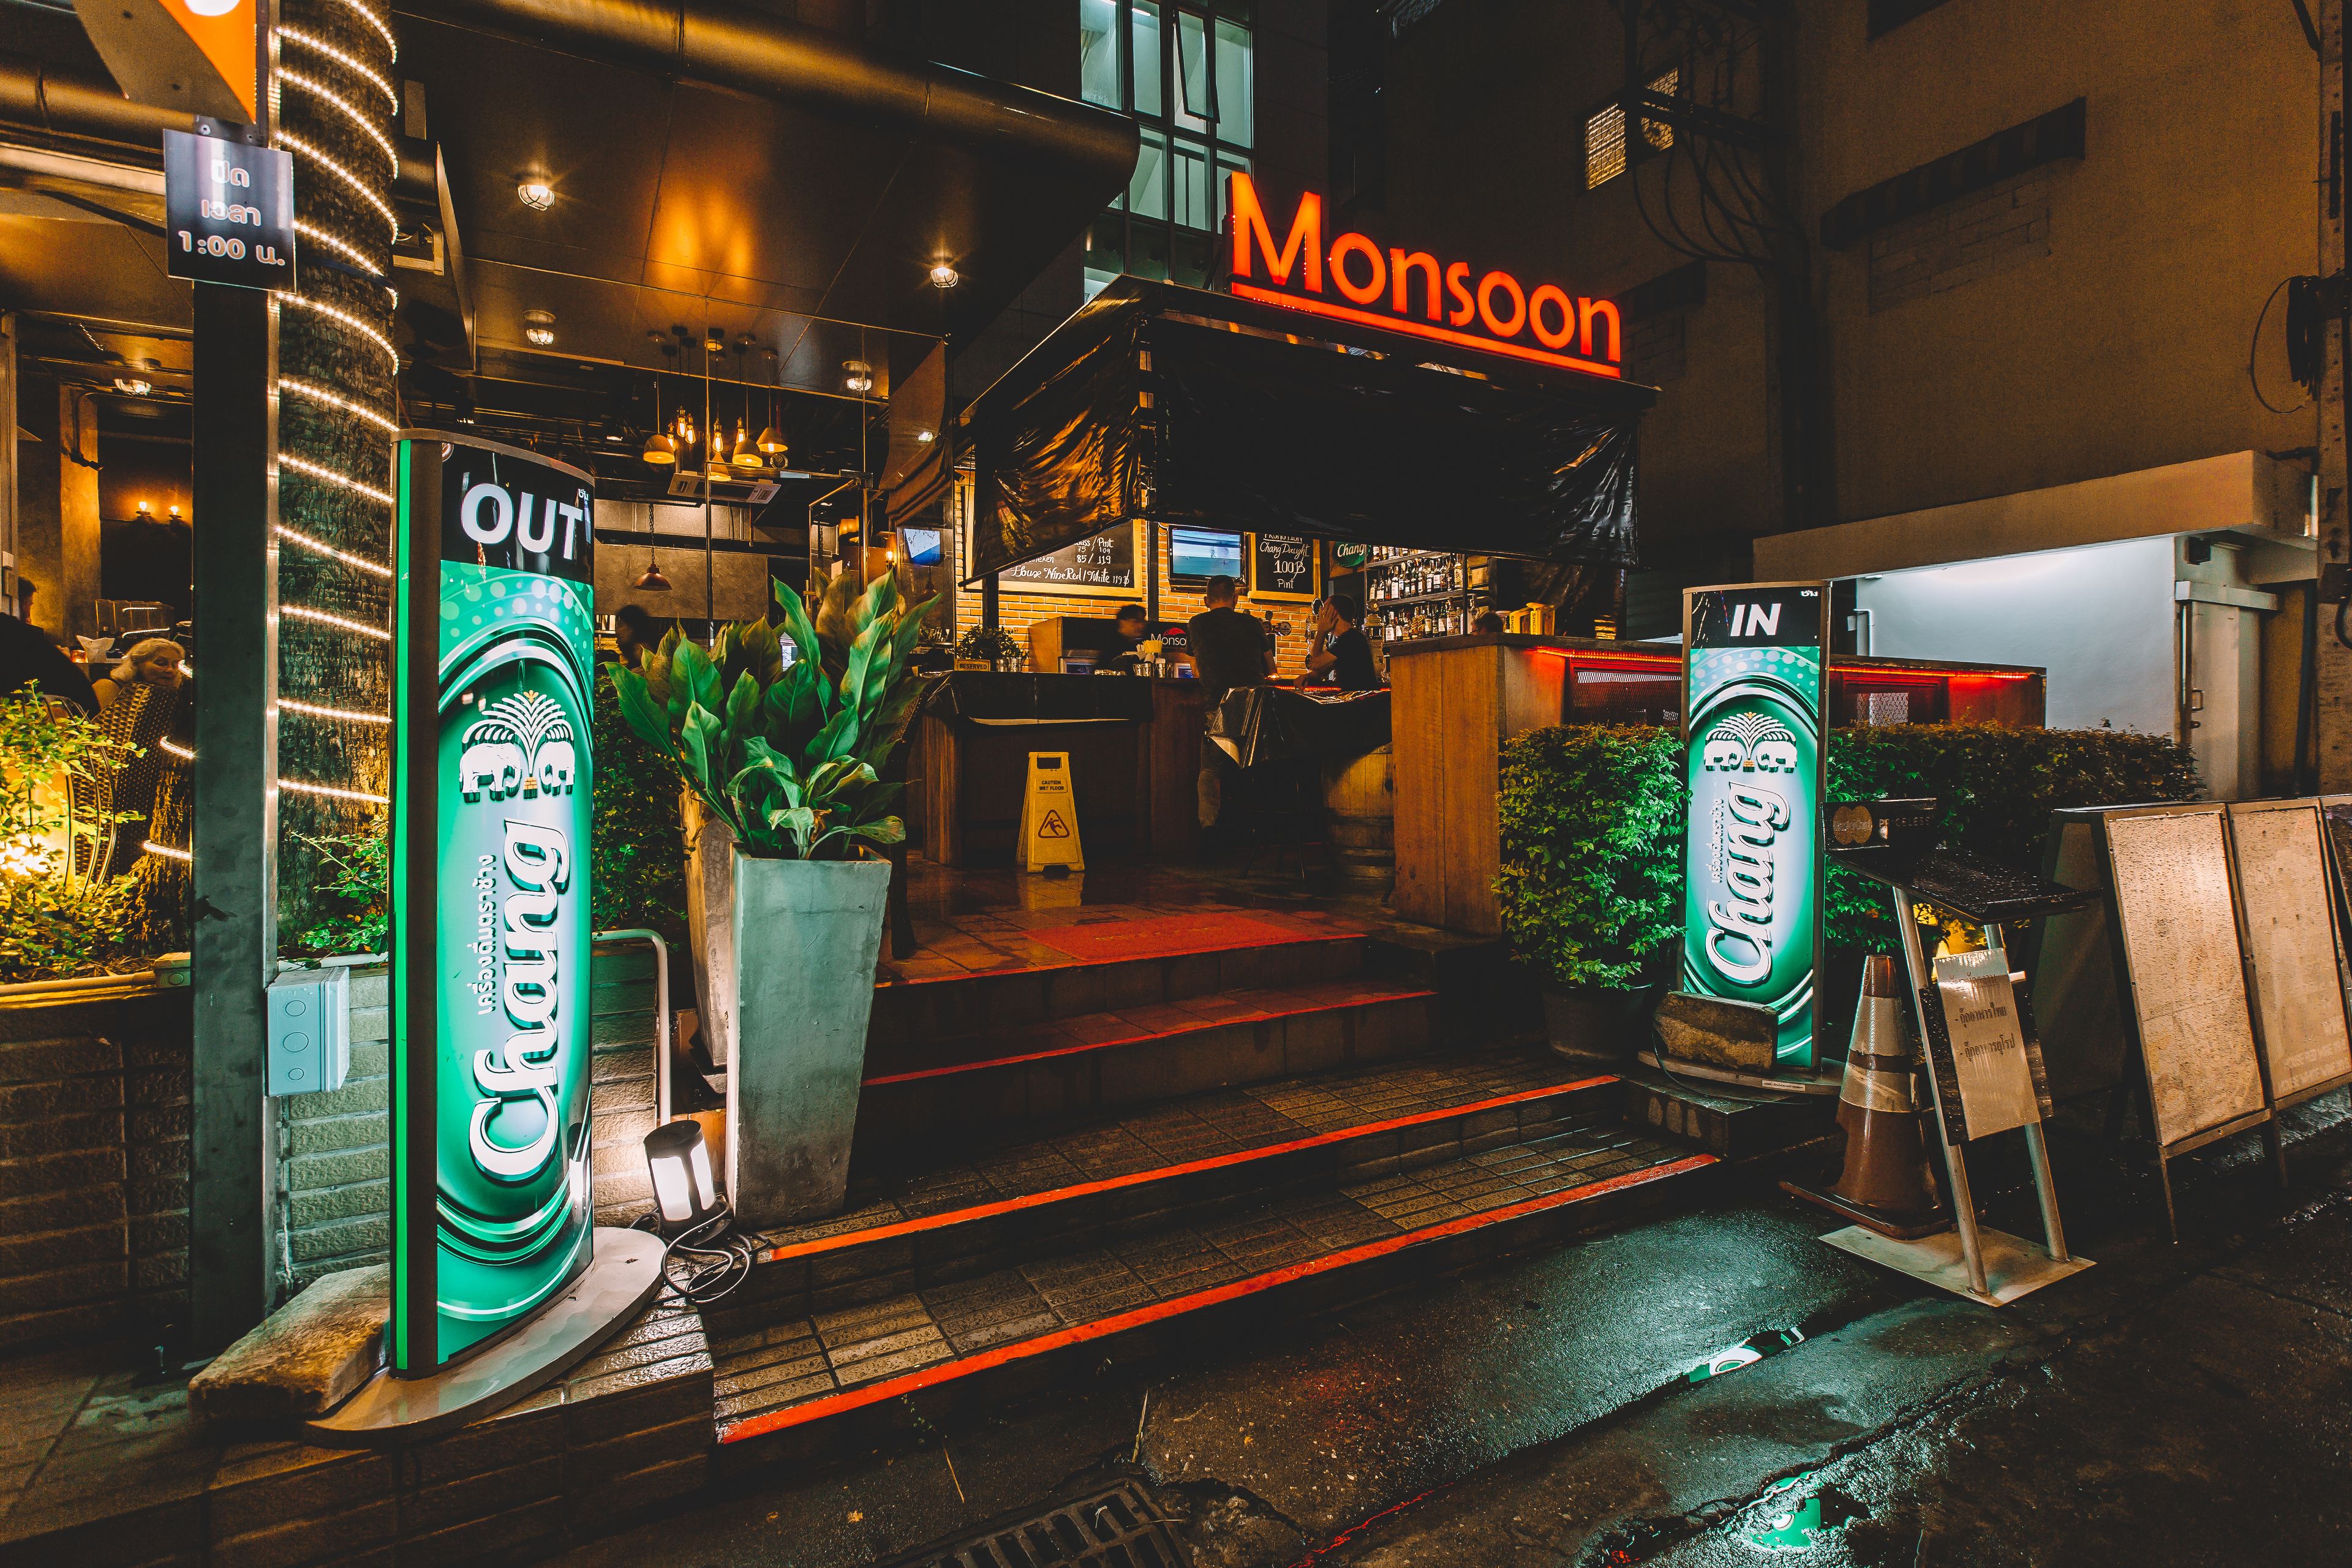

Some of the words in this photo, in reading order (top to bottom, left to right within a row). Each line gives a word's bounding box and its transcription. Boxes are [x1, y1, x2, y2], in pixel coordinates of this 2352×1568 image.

[201, 199, 262, 226] เวลา
[178, 230, 246, 260] 1:00
[256, 245, 285, 266] น.
[1231, 172, 1621, 363] Monsoon
[461, 483, 583, 560] OUT
[1260, 541, 1281, 559] Chang
[1337, 543, 1365, 557] Chang
[1277, 578, 1294, 589] Pint
[1730, 603, 1782, 636] IN
[1151, 633, 1187, 646] Monso
[1879, 816, 1930, 827] PRCELESS
[1705, 781, 1791, 987] Chang
[467, 854, 497, 1016] เครื่องดื่มตราช้าง
[469, 818, 571, 1183] Chang
